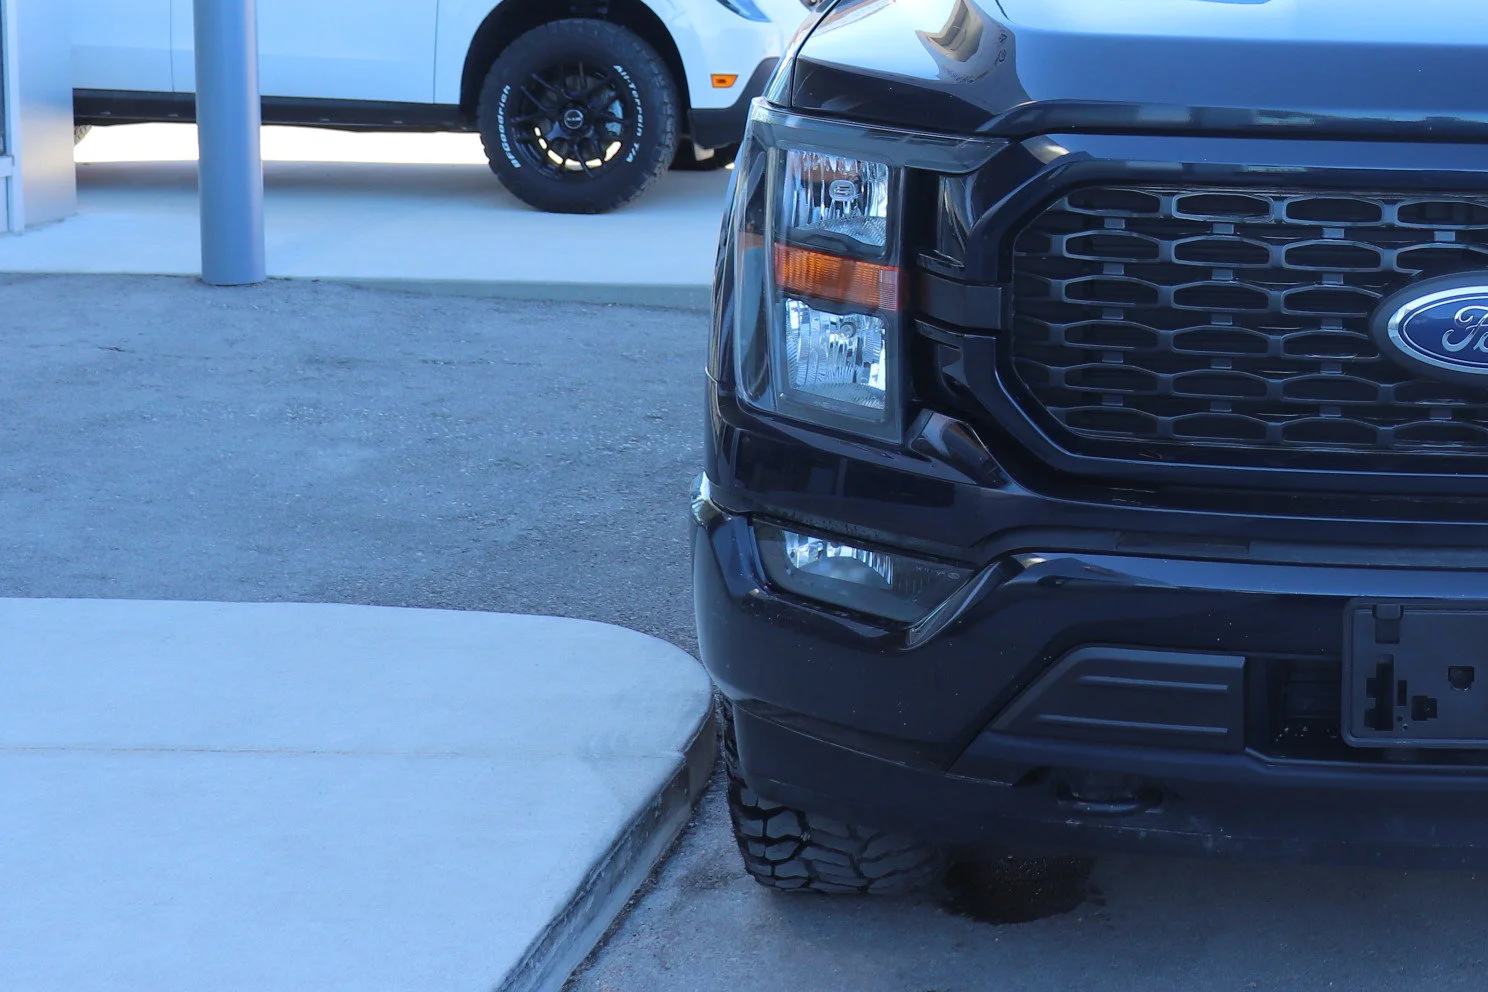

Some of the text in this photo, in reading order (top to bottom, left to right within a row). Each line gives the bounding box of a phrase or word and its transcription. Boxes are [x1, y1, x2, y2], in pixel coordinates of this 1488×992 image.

[497, 84, 522, 168] BFGoodrich
[613, 65, 644, 163] All-Terrain T/A
